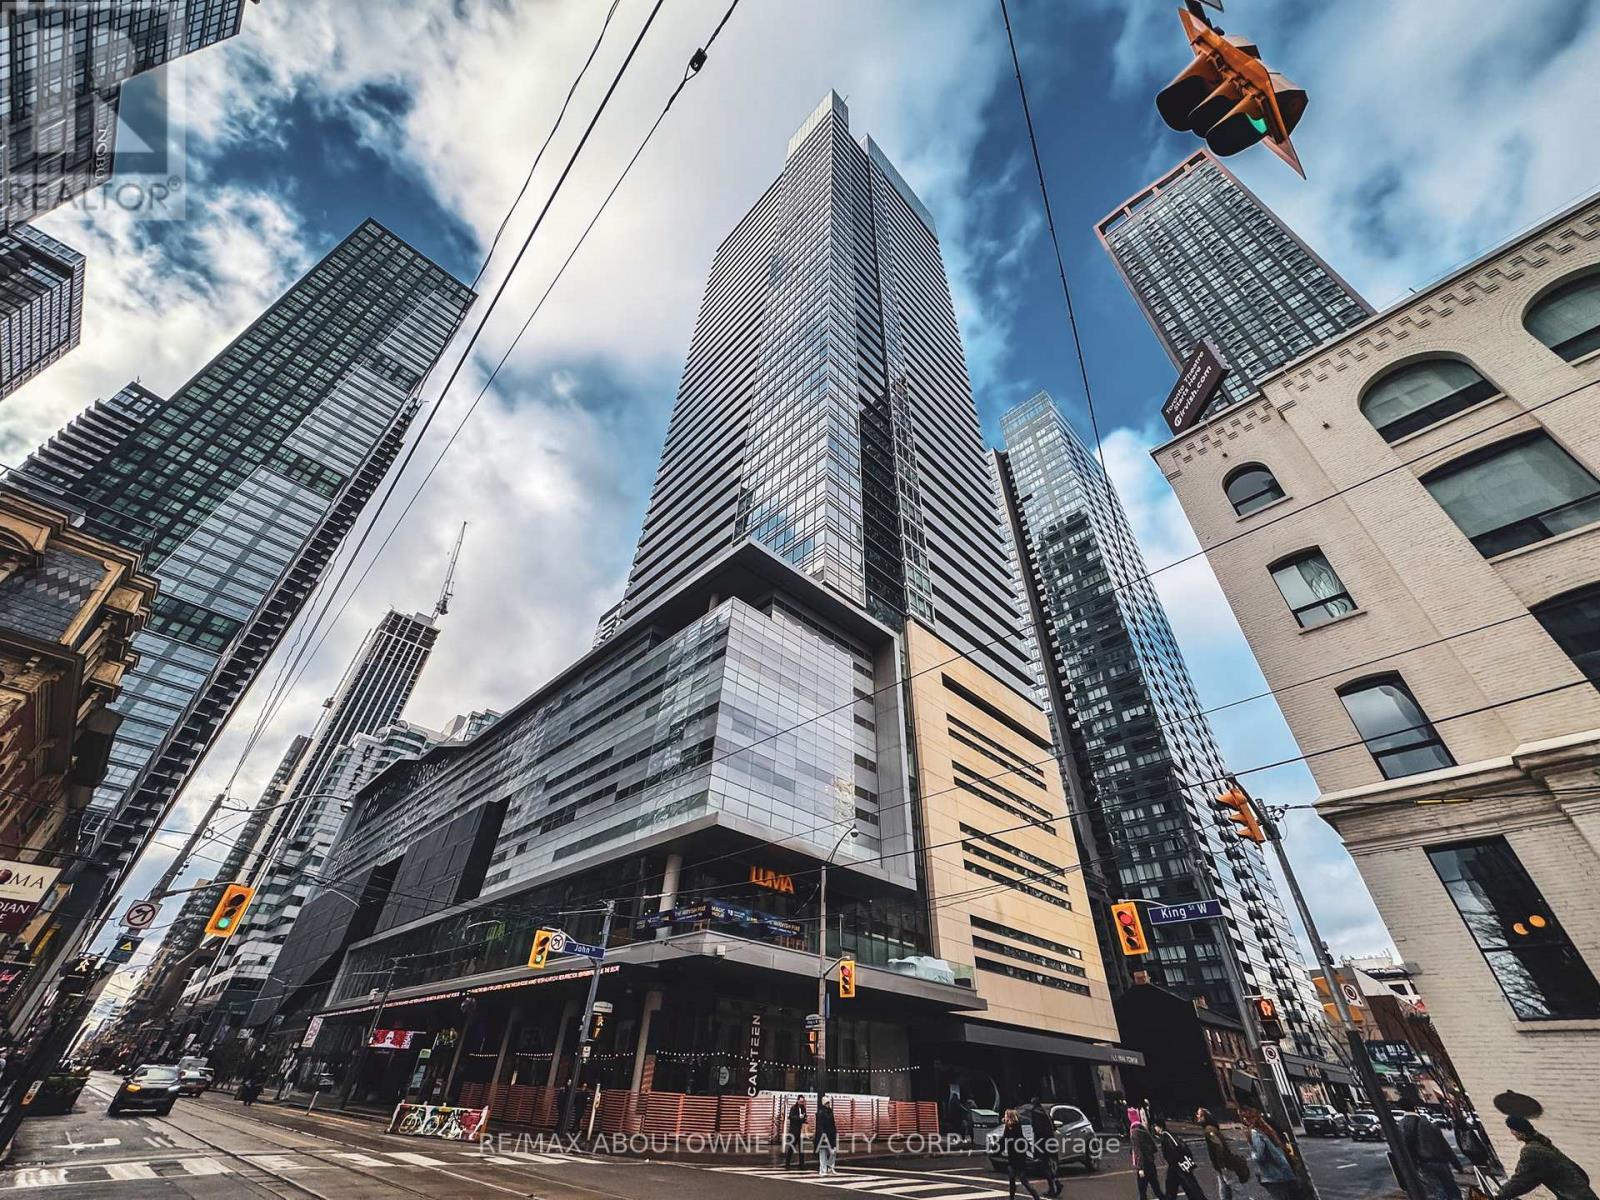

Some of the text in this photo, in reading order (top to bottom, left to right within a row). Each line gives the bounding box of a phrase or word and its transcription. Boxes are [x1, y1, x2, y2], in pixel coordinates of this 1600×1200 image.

[95, 128, 108, 180] NOBU
[1166, 351, 1204, 414] Toronto Theatre
[1174, 366, 1201, 412] Starts Here
[349, 744, 375, 790] HYATT
[1161, 908, 1187, 919] King
[1197, 903, 1207, 914] W
[574, 944, 590, 954] John
[747, 1015, 761, 1097] CANTEEN
